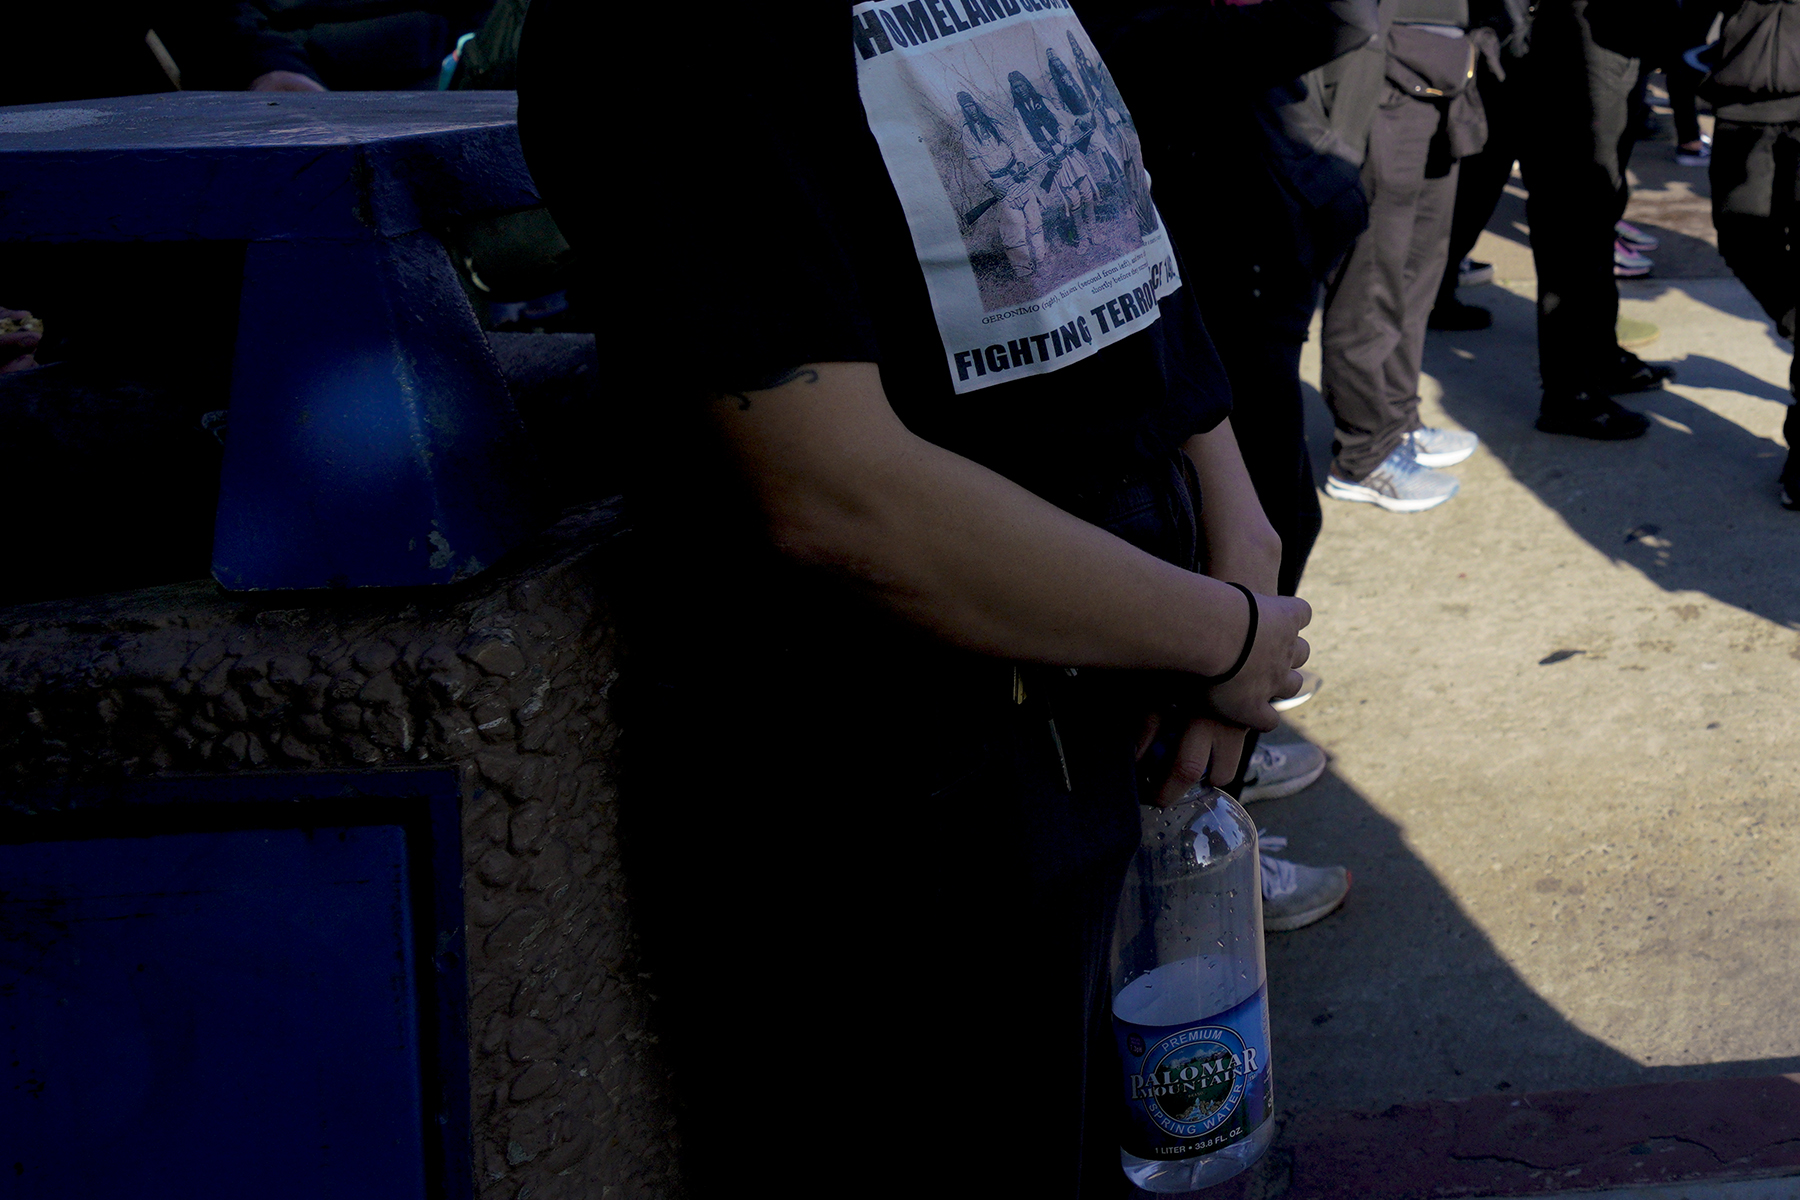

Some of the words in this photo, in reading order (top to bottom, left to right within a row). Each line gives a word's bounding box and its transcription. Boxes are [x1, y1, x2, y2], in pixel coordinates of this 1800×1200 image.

[981, 304, 1040, 325] GERONIMO
[1102, 266, 1119, 281] from
[1091, 280, 1113, 296] shortly
[1112, 271, 1131, 285] before
[954, 315, 1093, 382] FIGHTING
[1090, 279, 1158, 335] TERRO
[1162, 1029, 1223, 1052] PREMIUM
[1130, 1047, 1259, 1099] PALOMAR
[1139, 1068, 1242, 1099] MOUNTAIN
[1149, 1103, 1197, 1135] SPRING
[1203, 1084, 1243, 1130] WATER
[1161, 1145, 1186, 1155] LITER
[1194, 1138, 1214, 1151] 33.8
[1214, 1133, 1228, 1146] FL.
